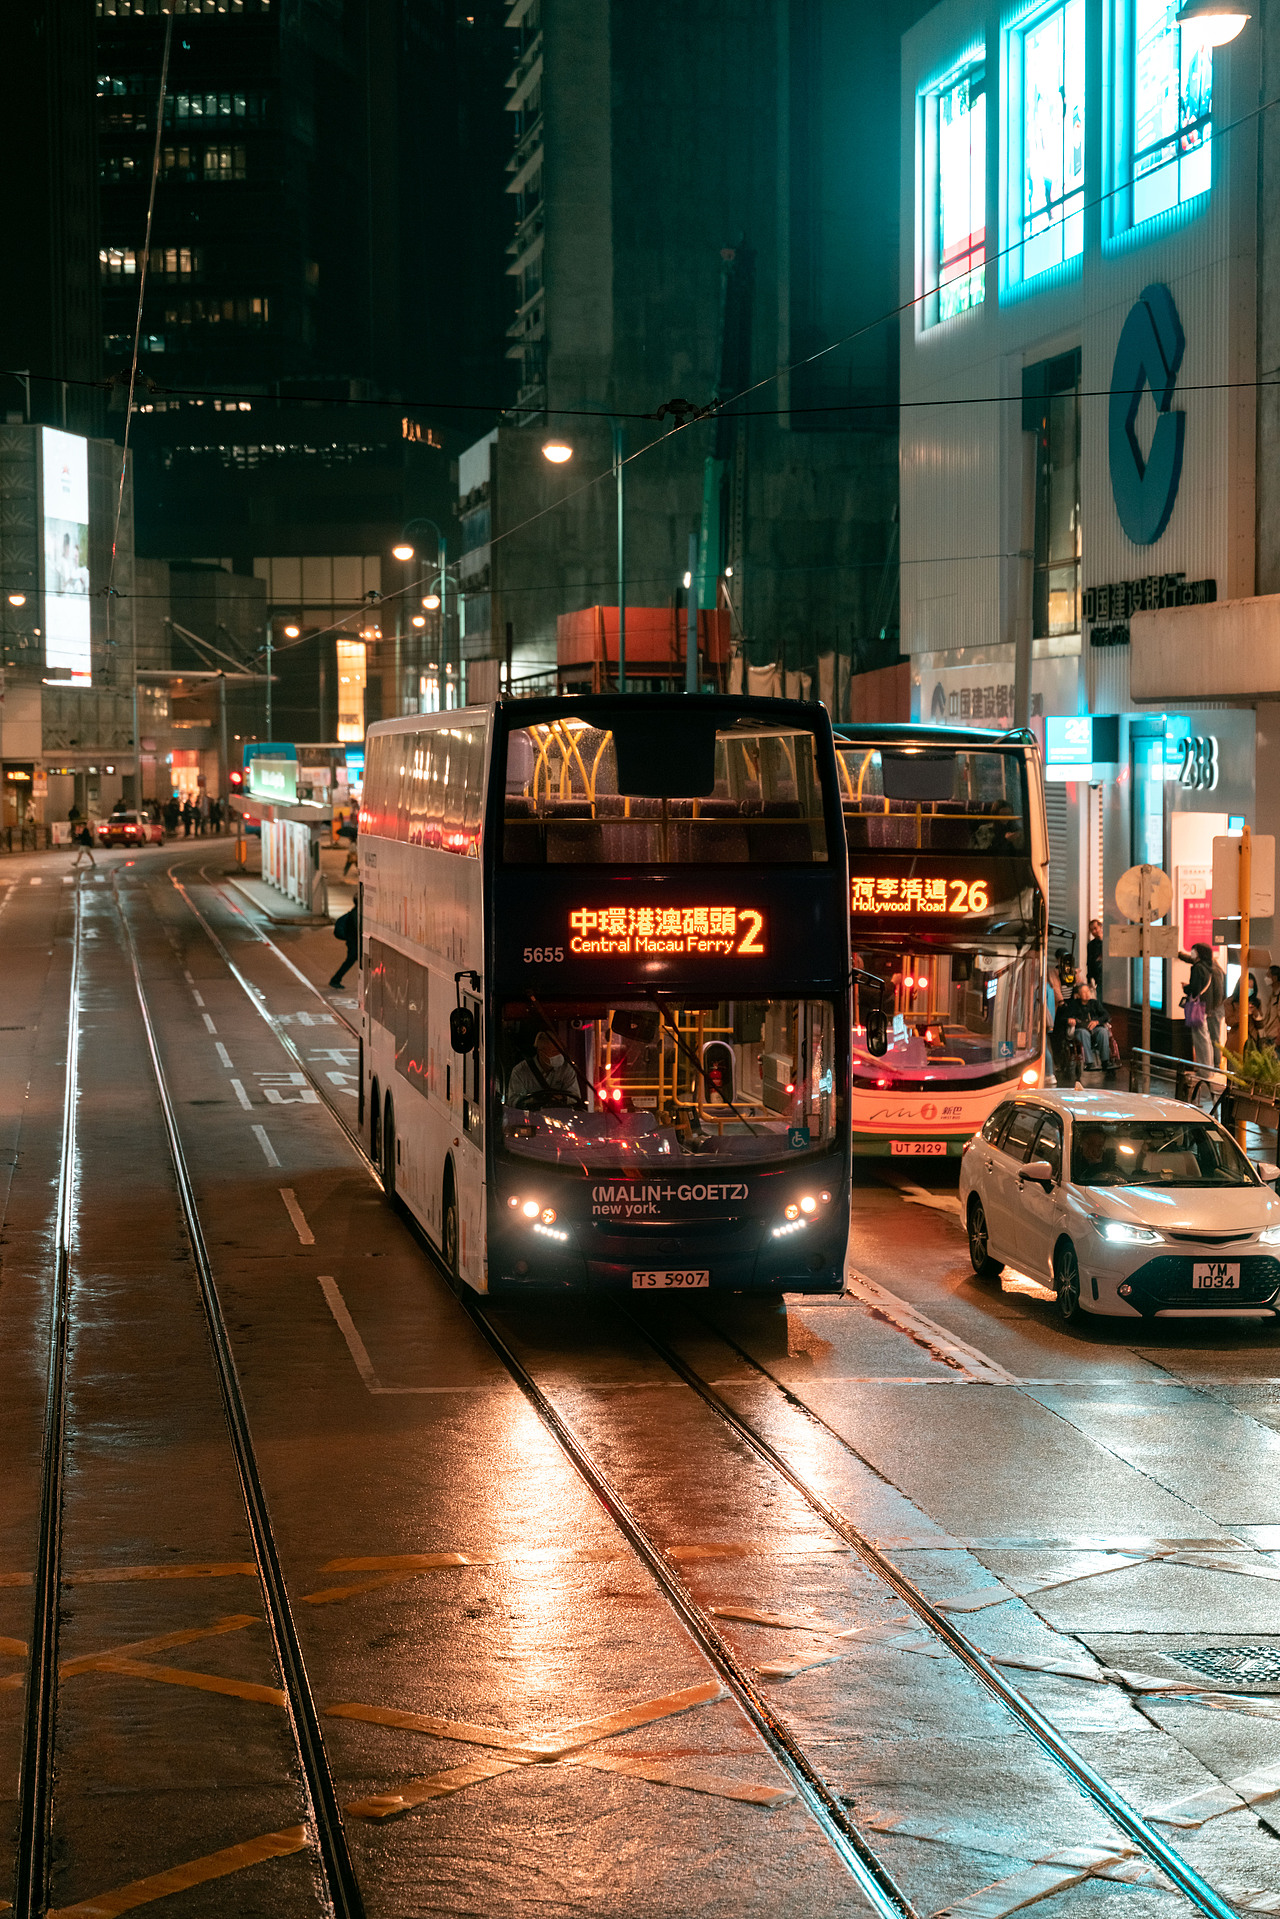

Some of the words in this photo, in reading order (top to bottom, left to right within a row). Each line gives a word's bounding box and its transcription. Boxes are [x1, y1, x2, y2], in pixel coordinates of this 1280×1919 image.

[851, 877, 947, 899] 荷李活道
[949, 880, 988, 912] 26
[852, 897, 911, 913] Hollywood
[917, 898, 946, 912] Road
[570, 907, 736, 936] 中環港澳碼頭
[737, 910, 764, 953] 2
[570, 937, 630, 952] Central
[635, 938, 684, 952] Macau
[687, 937, 734, 954] Ferry
[522, 947, 565, 963] 5655
[895, 1143, 911, 1153] UT
[914, 1143, 942, 1153] 2129
[592, 1184, 749, 1202] (MALIN+GOETZ)
[592, 1204, 622, 1215] new
[626, 1202, 661, 1217] york.
[1207, 1263, 1228, 1276] YM
[636, 1273, 657, 1286] TS
[664, 1272, 705, 1286] 5907
[1198, 1275, 1235, 1288] 1034
